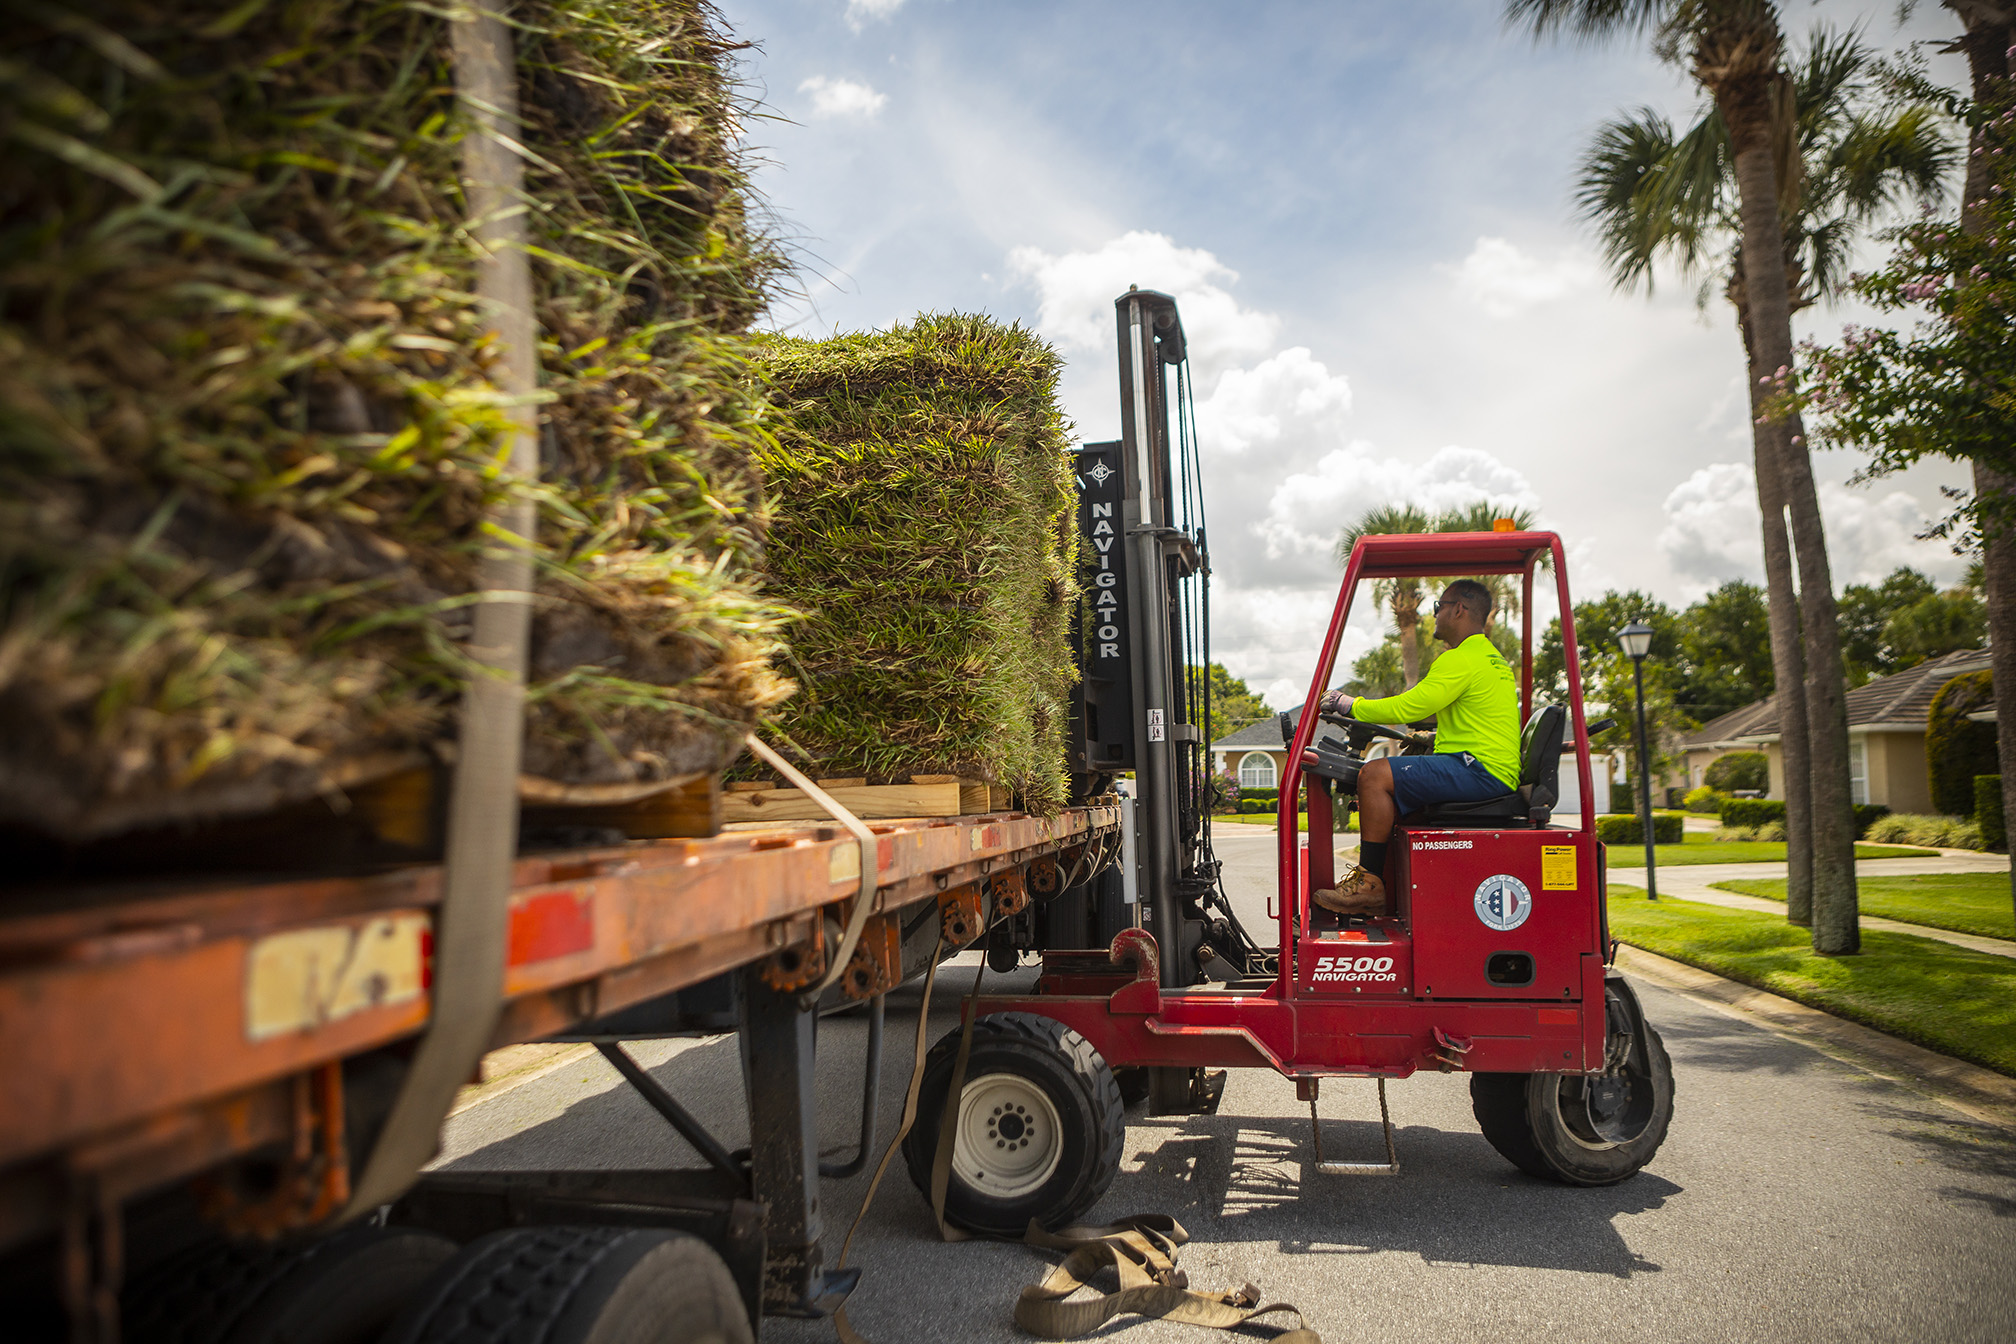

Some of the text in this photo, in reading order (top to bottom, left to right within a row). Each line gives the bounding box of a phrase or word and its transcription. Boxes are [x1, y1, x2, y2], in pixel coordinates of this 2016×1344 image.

[1092, 502, 1120, 658] NAVIGATOR
[1412, 840, 1473, 850] NO PASSENGERS
[1475, 874, 1531, 901] NAVIGATOR
[1314, 957, 1394, 973] 5500
[1312, 972, 1397, 982] NAVIGATOR
